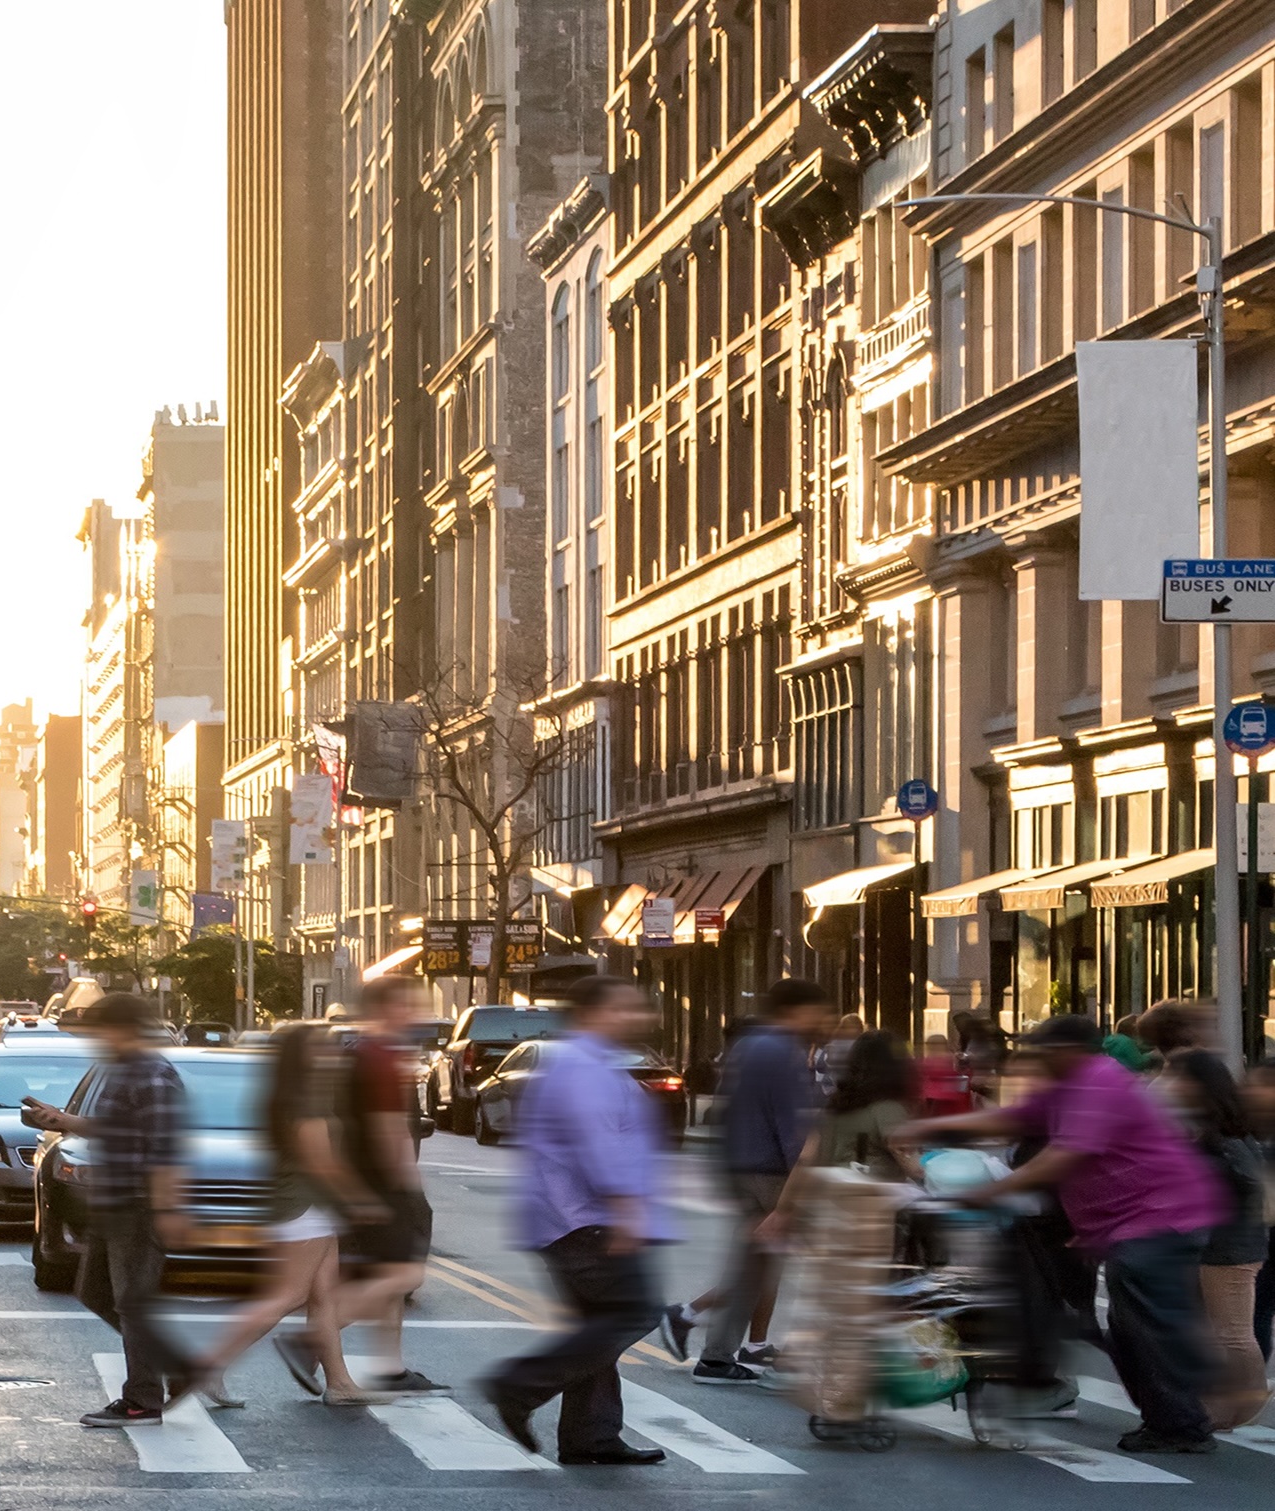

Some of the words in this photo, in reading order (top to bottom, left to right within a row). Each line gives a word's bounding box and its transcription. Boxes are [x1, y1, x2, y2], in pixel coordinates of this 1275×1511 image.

[1195, 563, 1226, 574] BUS
[1231, 564, 1275, 574] LANE
[1170, 580, 1225, 592] BUSES
[1233, 580, 1275, 592] ONLY
